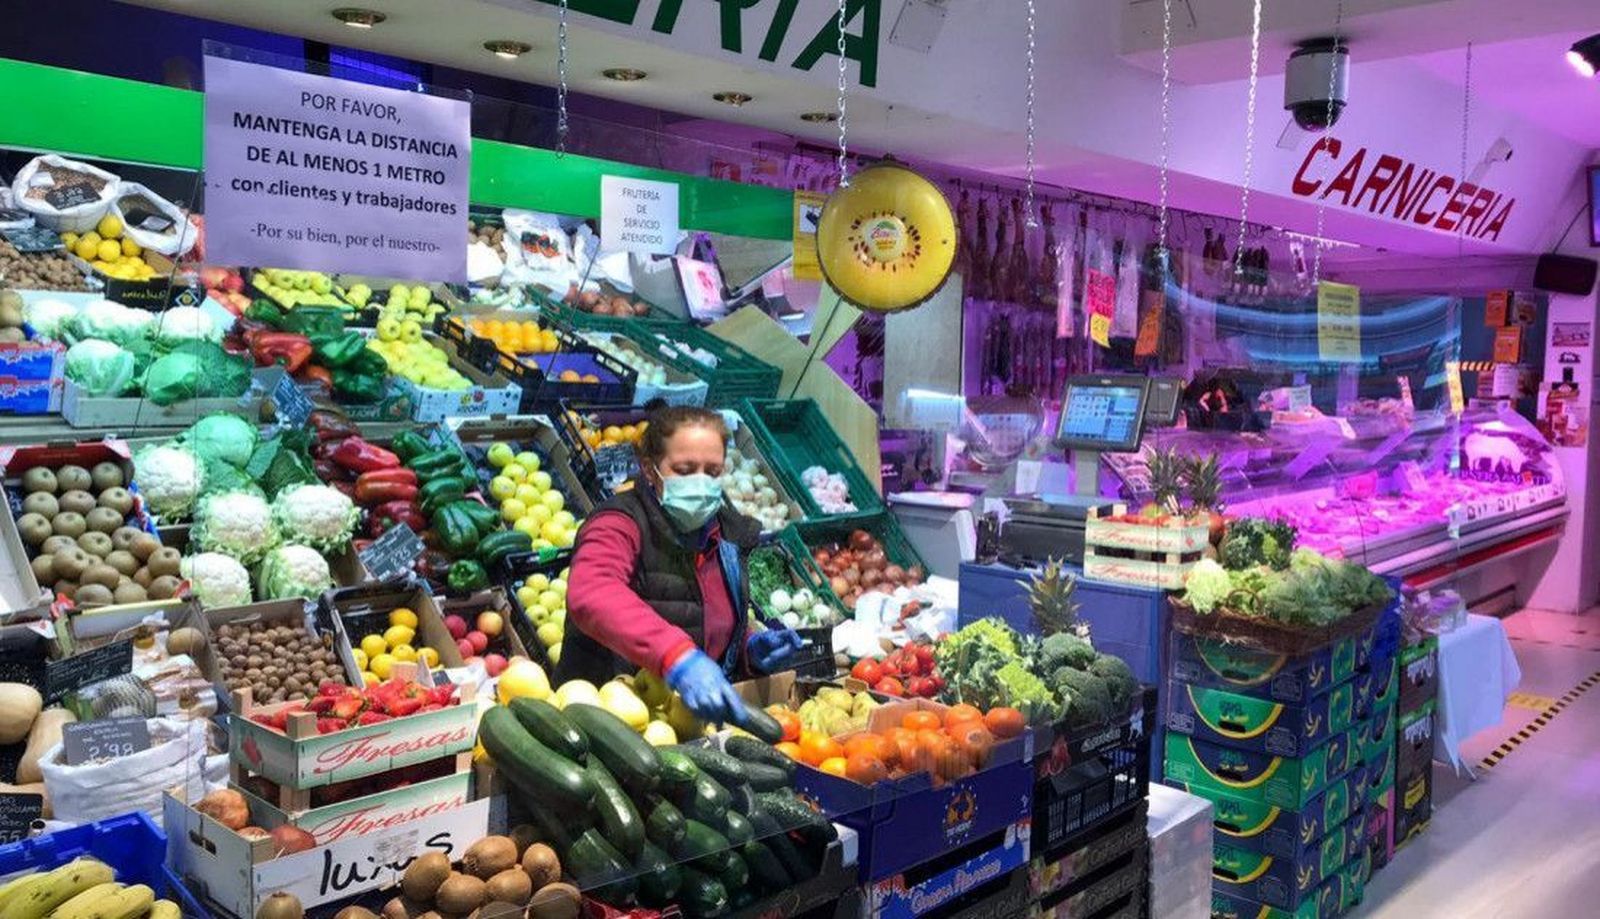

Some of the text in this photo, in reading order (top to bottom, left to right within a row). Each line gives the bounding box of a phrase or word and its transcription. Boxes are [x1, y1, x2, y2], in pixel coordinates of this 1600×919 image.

[300, 91, 402, 124] POR FAVOR,
[233, 111, 458, 159] MANTENGA LA DISTANCIA
[246, 145, 445, 186] DE AL MENOS 1 METRO
[231, 177, 458, 215] con clientes y trabajadores
[1291, 136, 1516, 242] CARNICERIA
[623, 217, 660, 231] SERVICIO
[636, 204, 648, 215] DE
[250, 222, 441, 253] -Por su bien, por el nuestro-
[621, 232, 663, 246] ATENDIDO
[313, 726, 469, 776] Fresas
